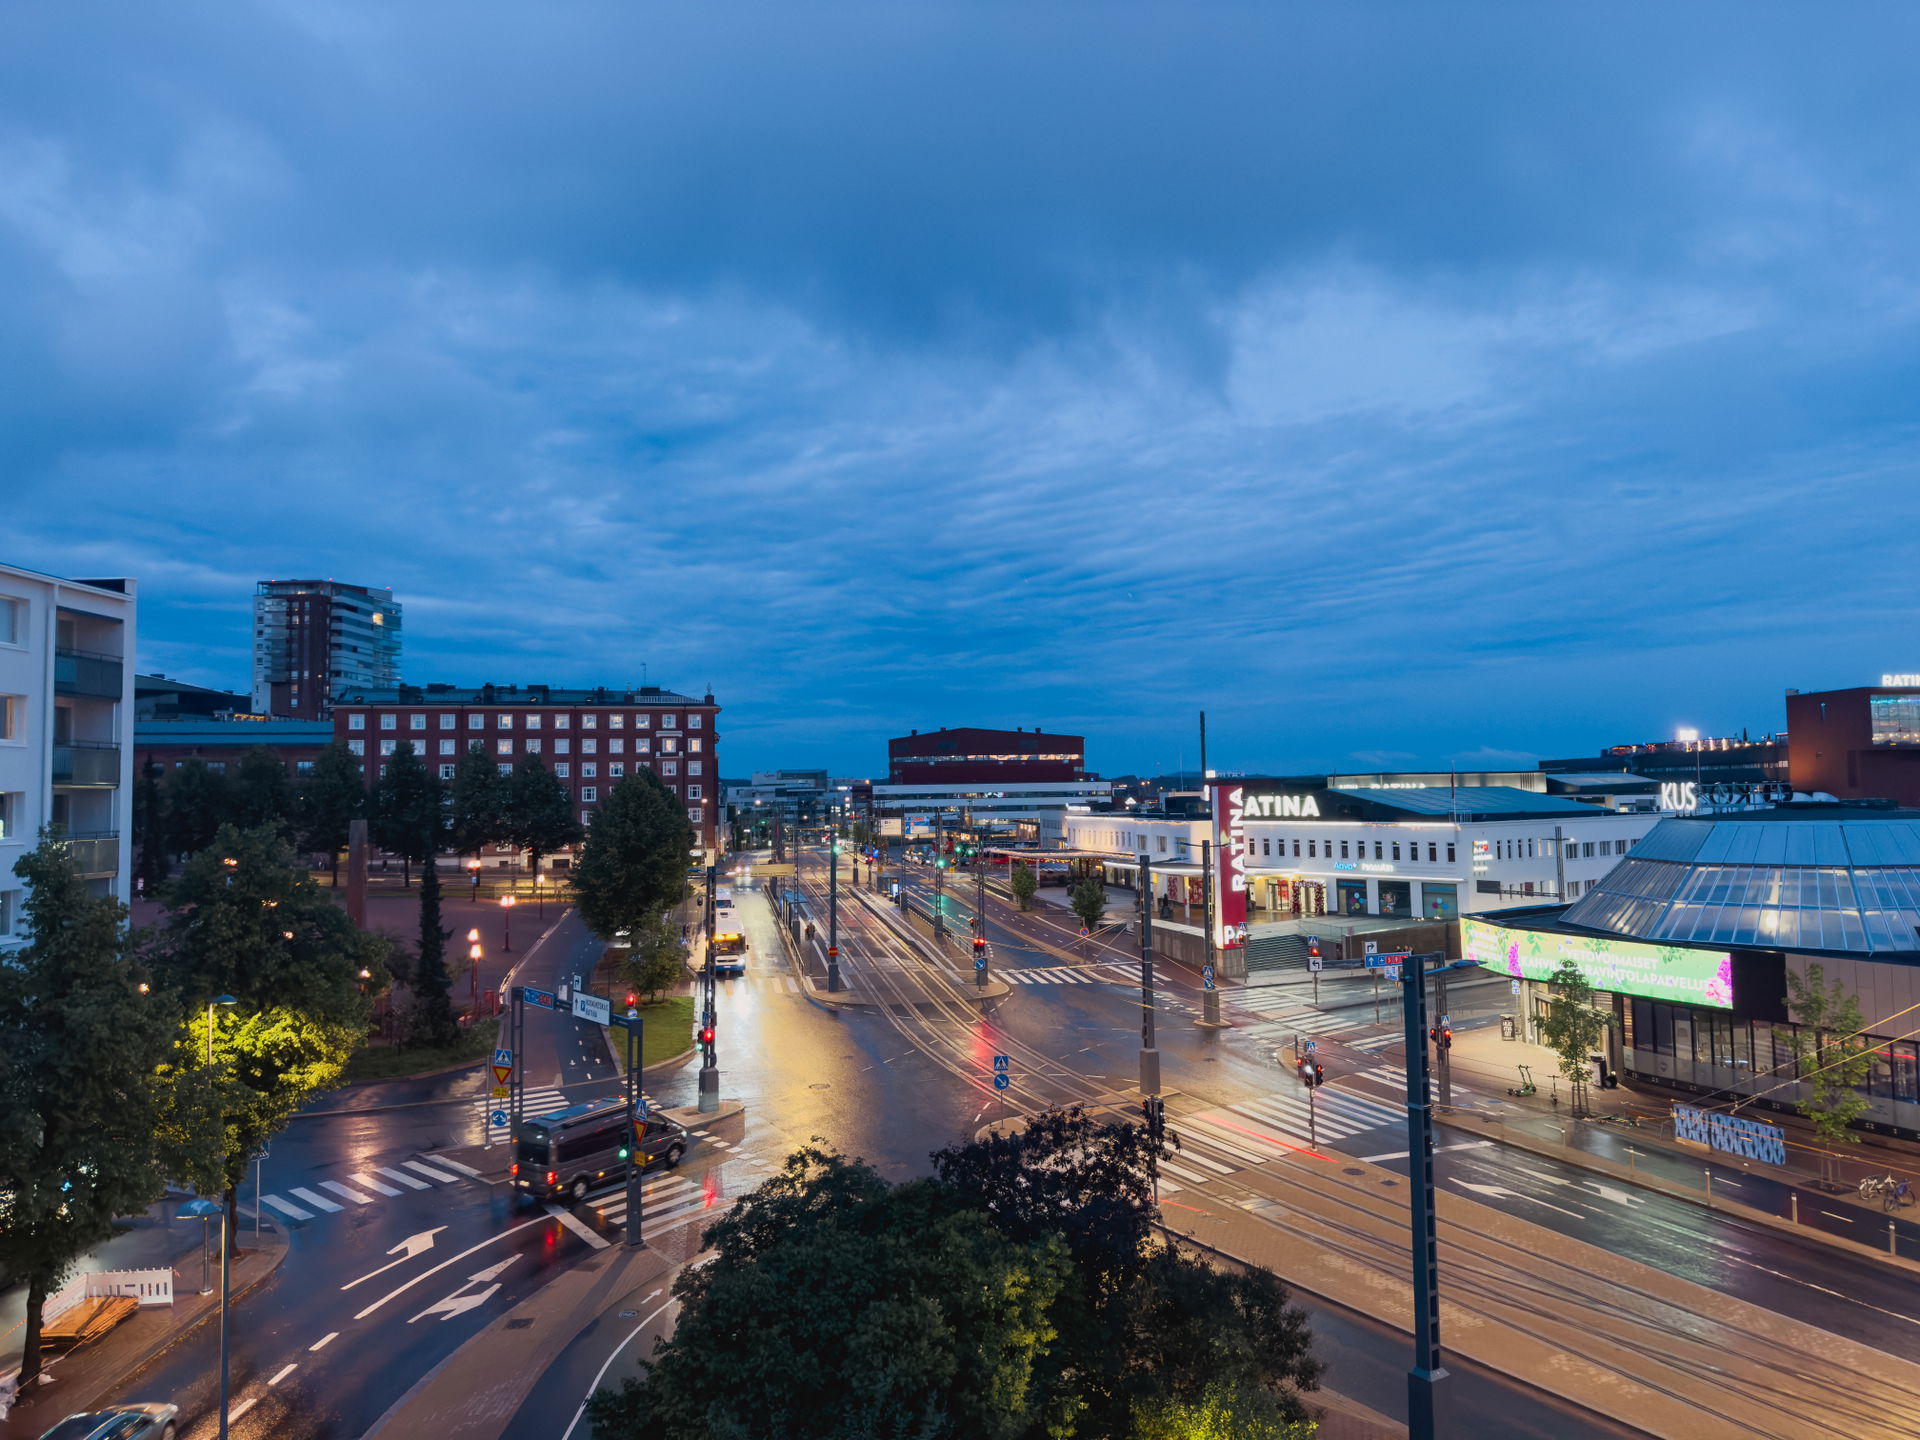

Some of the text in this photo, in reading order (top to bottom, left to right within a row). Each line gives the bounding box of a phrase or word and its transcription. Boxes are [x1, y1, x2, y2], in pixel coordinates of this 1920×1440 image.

[1244, 795, 1320, 817] ATINA
[1661, 782, 1696, 810] KUS
[1229, 787, 1245, 892] RATINA
